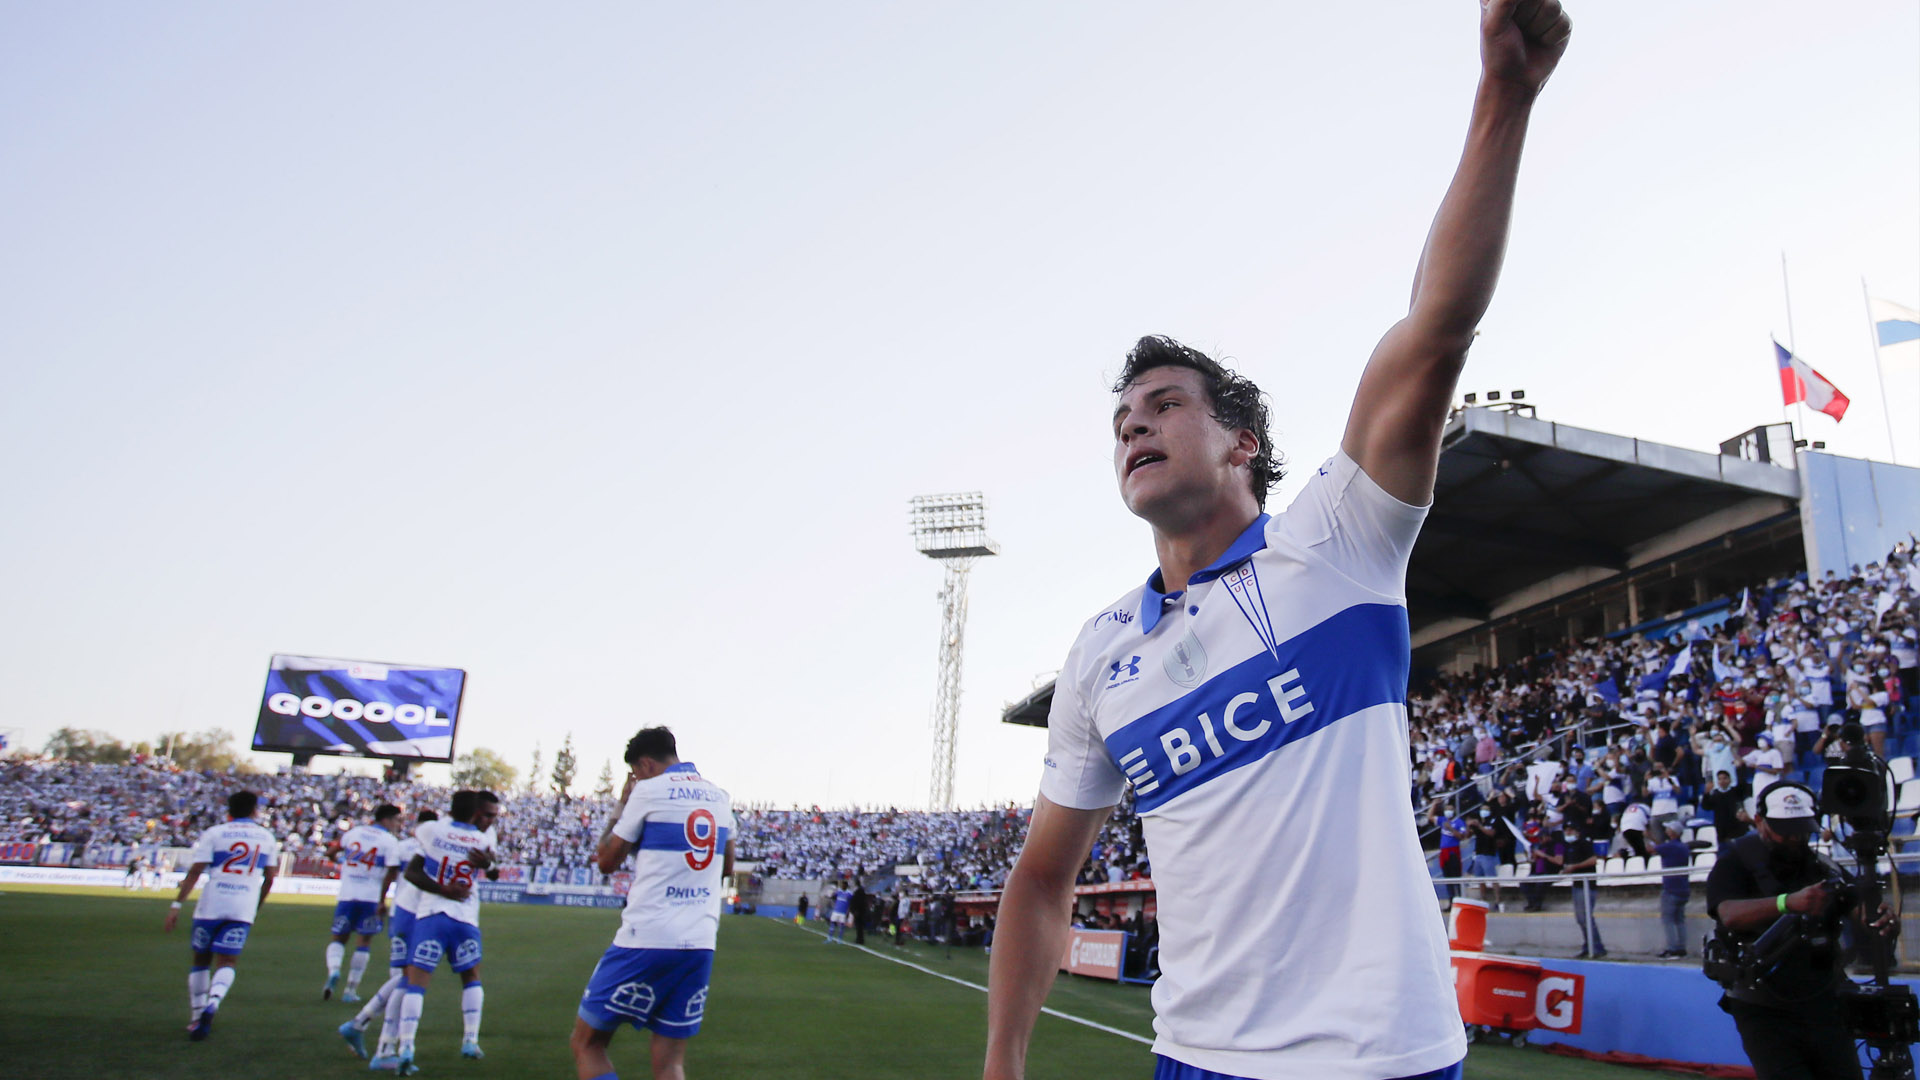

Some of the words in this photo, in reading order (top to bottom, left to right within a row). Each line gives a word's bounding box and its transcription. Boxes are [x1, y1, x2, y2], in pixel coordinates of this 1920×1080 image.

[1234, 585, 1241, 593] U
[1241, 568, 1249, 576] D
[268, 692, 450, 727] GOOOOL
[1160, 668, 1315, 776] BICE
[346, 841, 378, 871] 24
[684, 808, 717, 872] 9
[222, 841, 261, 876] 21
[437, 856, 475, 888] 18
[1536, 976, 1575, 1028] G
